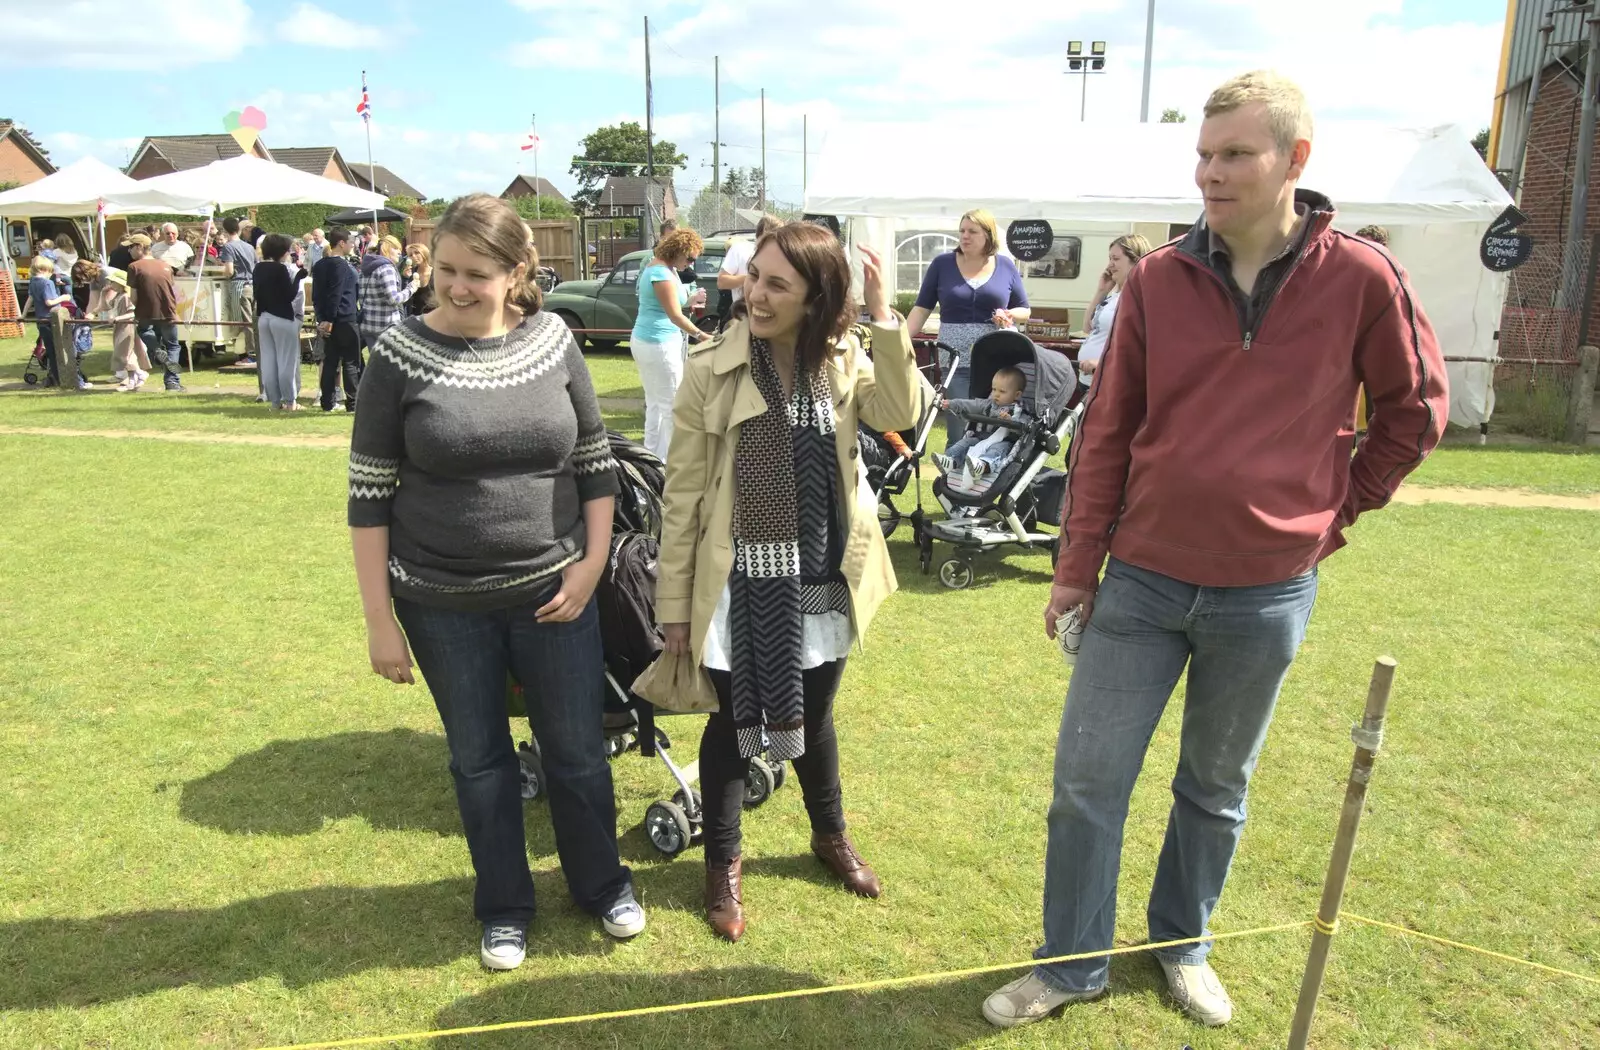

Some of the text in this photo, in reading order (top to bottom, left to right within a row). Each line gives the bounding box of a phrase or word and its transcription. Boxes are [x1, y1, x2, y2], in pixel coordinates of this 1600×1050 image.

[1486, 236, 1521, 247] CHOCOLATE
[1487, 246, 1519, 257] BROWNIE
[1495, 257, 1507, 267] £2
